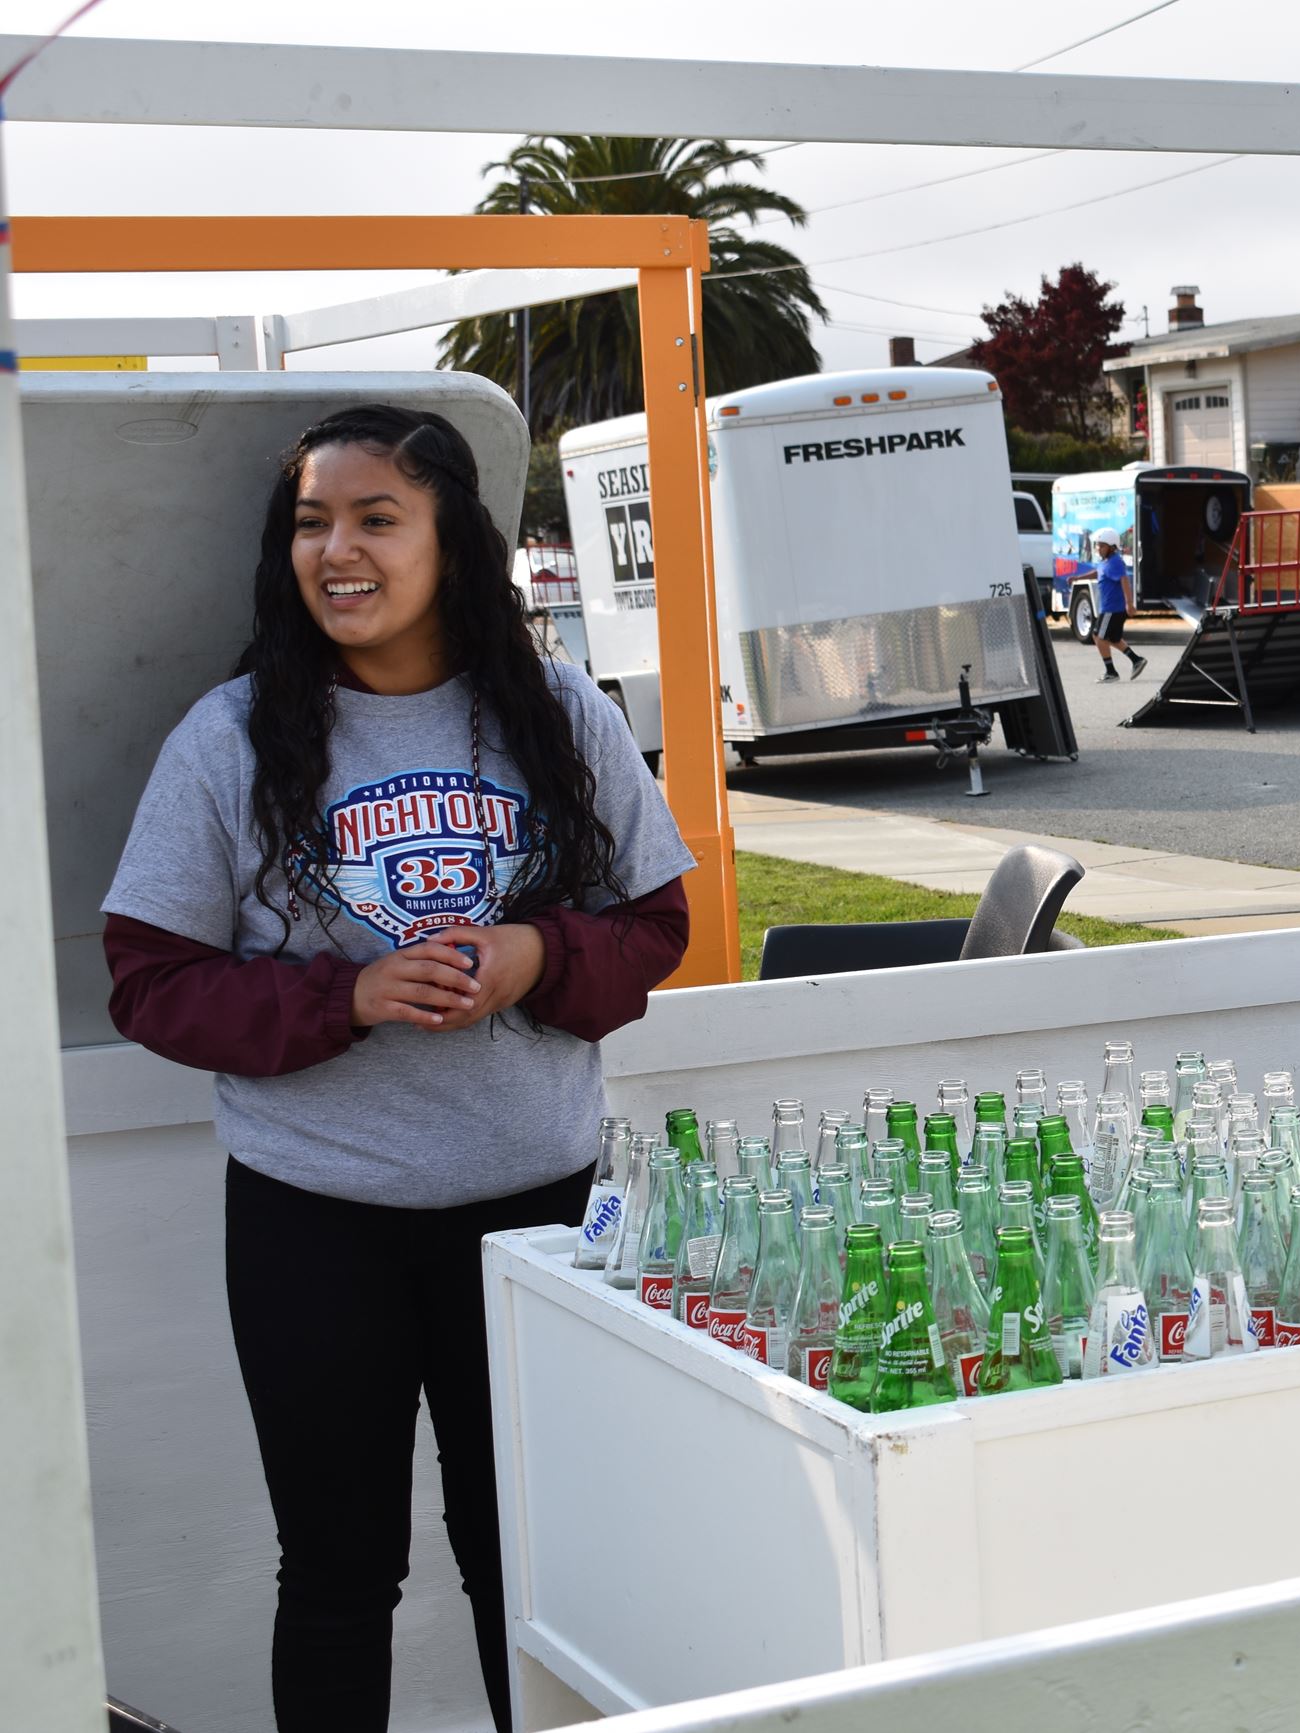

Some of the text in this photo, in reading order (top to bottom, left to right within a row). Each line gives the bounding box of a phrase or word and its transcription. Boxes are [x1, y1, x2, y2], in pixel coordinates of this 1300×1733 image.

[783, 428, 966, 464] FRESHPARK
[989, 582, 1012, 598] 725
[375, 775, 470, 797] NATIONAL
[334, 790, 520, 861] NIGHT OUT
[397, 851, 481, 897] 35
[405, 894, 477, 910] ANNIVERSARY
[425, 914, 456, 926] 2018
[583, 1195, 621, 1243] Fanta
[838, 1280, 879, 1330] Sprite
[880, 1300, 924, 1350] Sprite
[1110, 1304, 1149, 1368] Fanta
